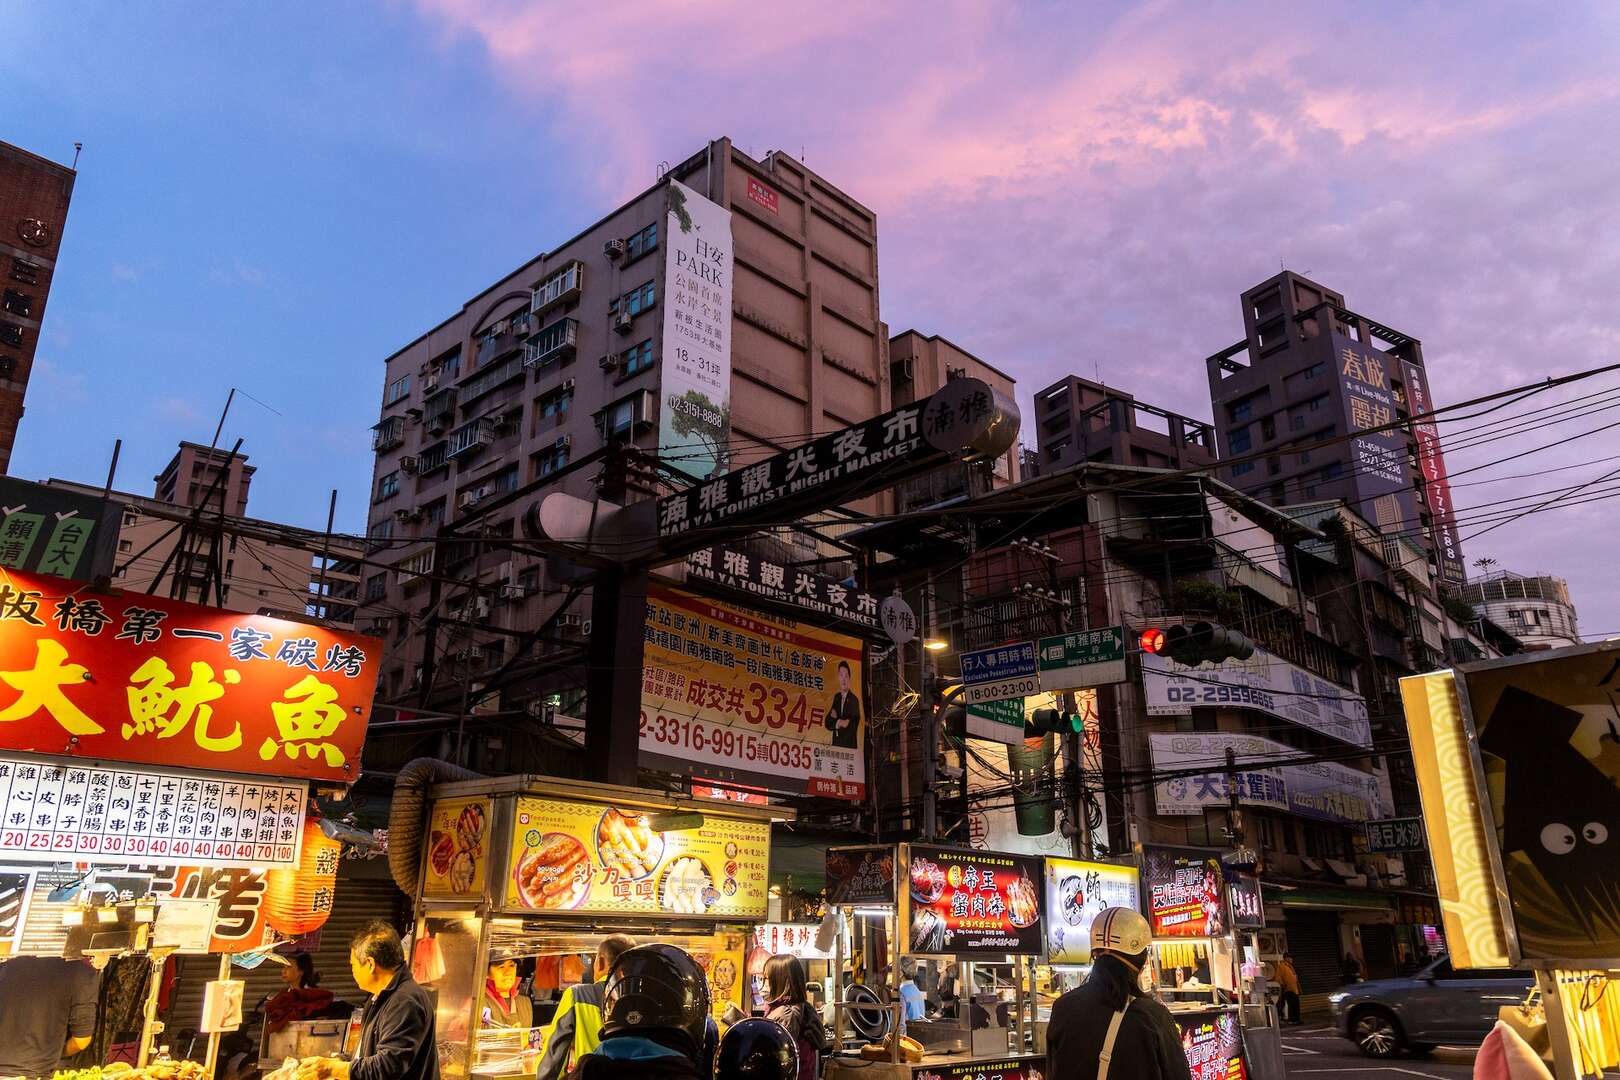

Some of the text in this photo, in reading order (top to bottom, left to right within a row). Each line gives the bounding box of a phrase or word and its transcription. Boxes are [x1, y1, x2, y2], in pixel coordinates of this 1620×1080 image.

[675, 248, 723, 289] PARK
[676, 347, 688, 362] 18
[669, 395, 722, 427] 02-3151-8888
[659, 436, 921, 537] NAN YA TOURIST NIGHT MARKET
[0, 518, 36, 568] 賴清
[46, 524, 82, 576] 台大
[741, 577, 795, 603] TOURIST
[797, 595, 834, 615] NIGHT
[834, 605, 880, 627] MARKET
[0, 585, 367, 679] 板橋第一家碳烤
[0, 638, 347, 768] 大魷魚
[686, 678, 825, 734] 成交共334戶
[970, 680, 1034, 700] 18:00-23:00
[9, 766, 36, 826] 雞心串
[36, 768, 61, 827] 雞皮串
[60, 770, 86, 829] 雞脖子
[133, 778, 156, 833] 七里香串
[155, 780, 177, 834] 七里香串
[177, 781, 200, 836] 豬五花肉串
[199, 783, 221, 837] 梅花肉串
[220, 785, 240, 838] 羊肉串
[240, 787, 260, 840] 牛肉串
[280, 790, 299, 841] 大魷魚串
[3, 832, 292, 859] 20 25 25 30 30 30 40 40 40 40 40 70 100
[104, 889, 134, 902] 公告
[613, 880, 655, 902] 嘎嘎
[951, 890, 1006, 919] 蟹肉棒
[962, 864, 998, 894] 帝王
[783, 926, 820, 947] 糖炒
